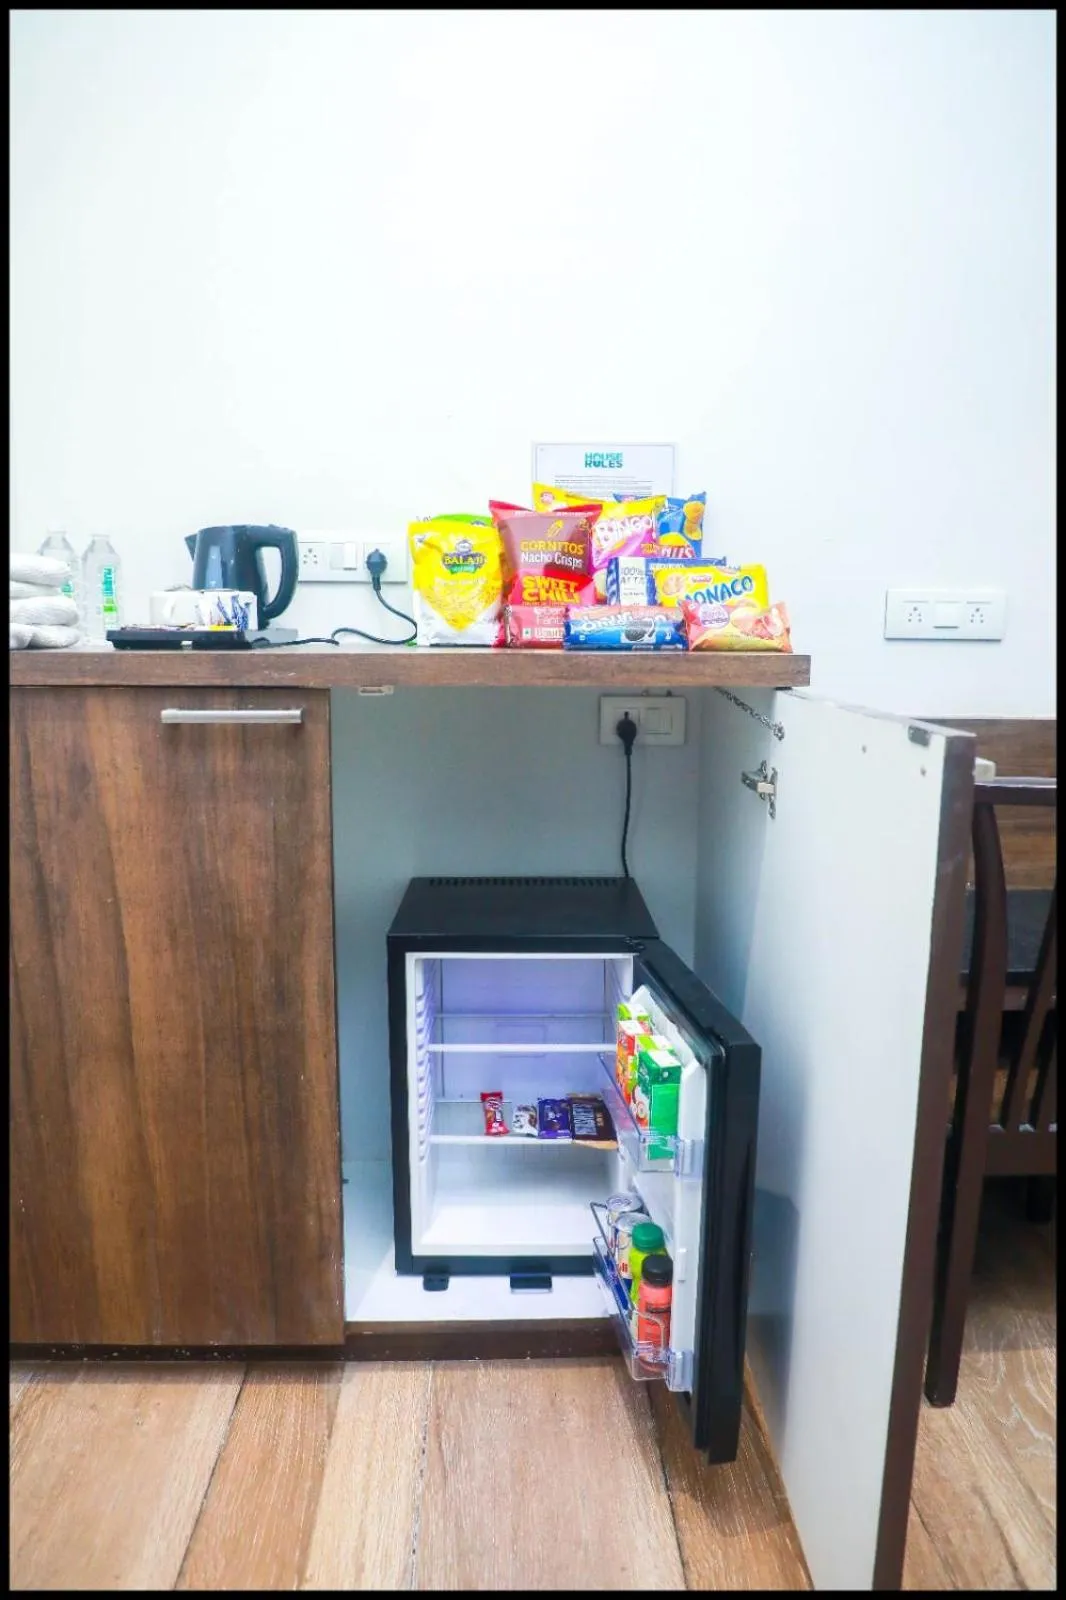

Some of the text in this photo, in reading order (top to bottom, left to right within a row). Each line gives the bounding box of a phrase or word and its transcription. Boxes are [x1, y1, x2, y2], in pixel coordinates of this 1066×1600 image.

[584, 452, 623, 461] HOUSE
[584, 460, 623, 469] RULES
[520, 540, 585, 556] CORNITOS
[444, 555, 484, 565] BALAJI
[521, 551, 583, 571] Nacho Crisps
[522, 575, 580, 593] SWEET
